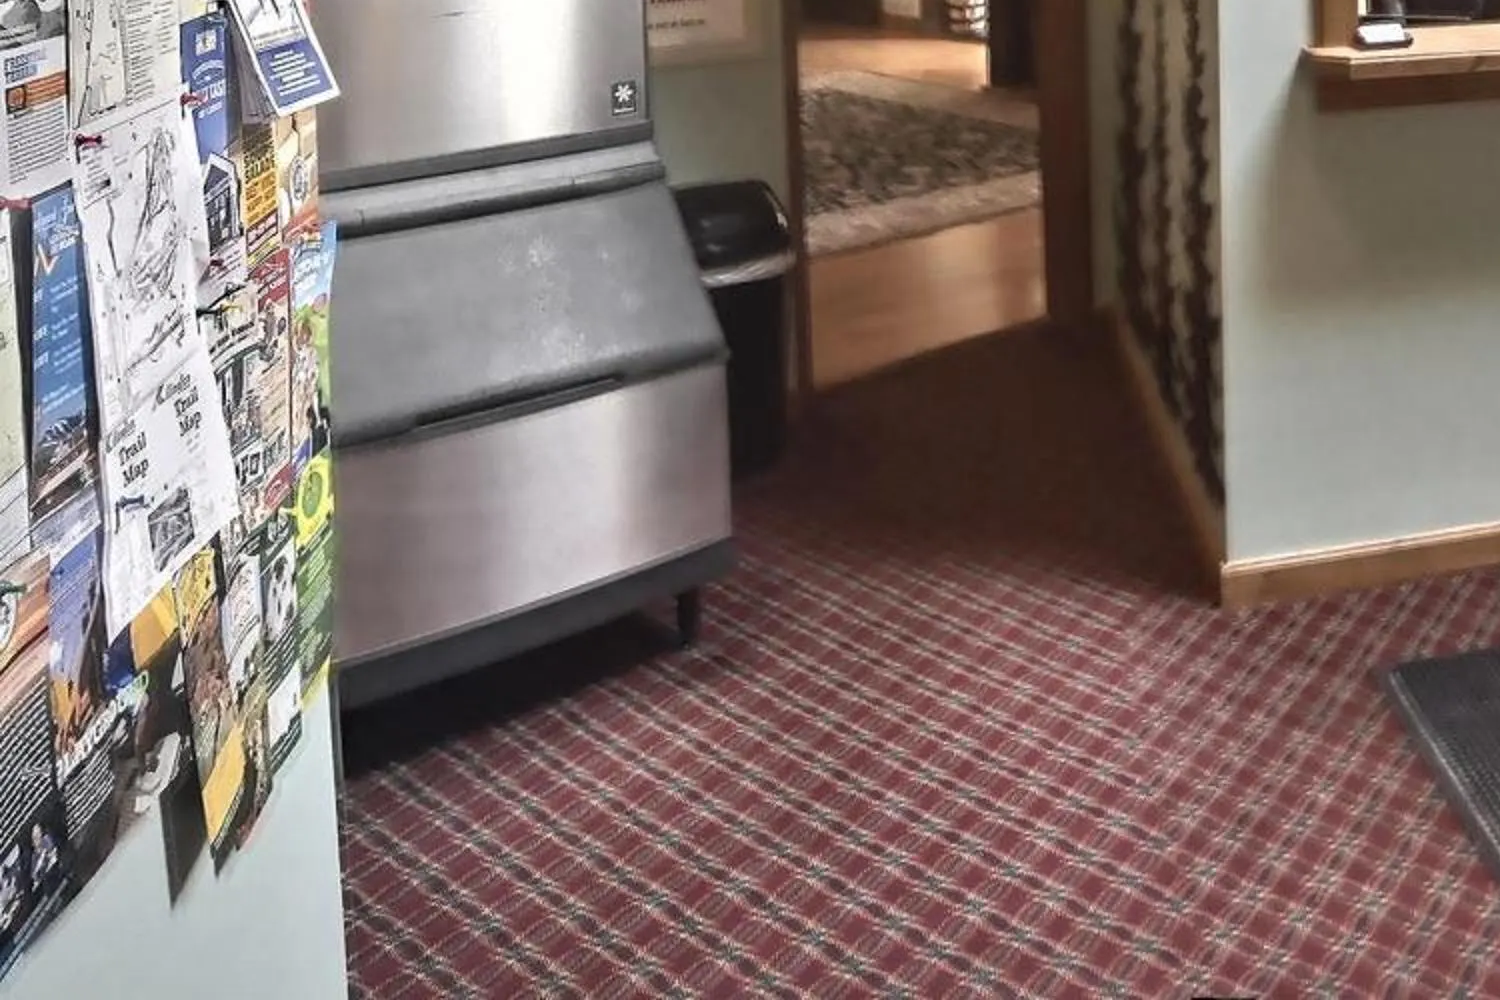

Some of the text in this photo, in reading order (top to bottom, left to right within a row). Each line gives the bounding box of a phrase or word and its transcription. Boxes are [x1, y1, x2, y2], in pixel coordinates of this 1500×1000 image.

[174, 386, 199, 418] Trail
[179, 411, 202, 437] Map
[119, 431, 147, 467] Trail
[122, 459, 149, 488] Map
